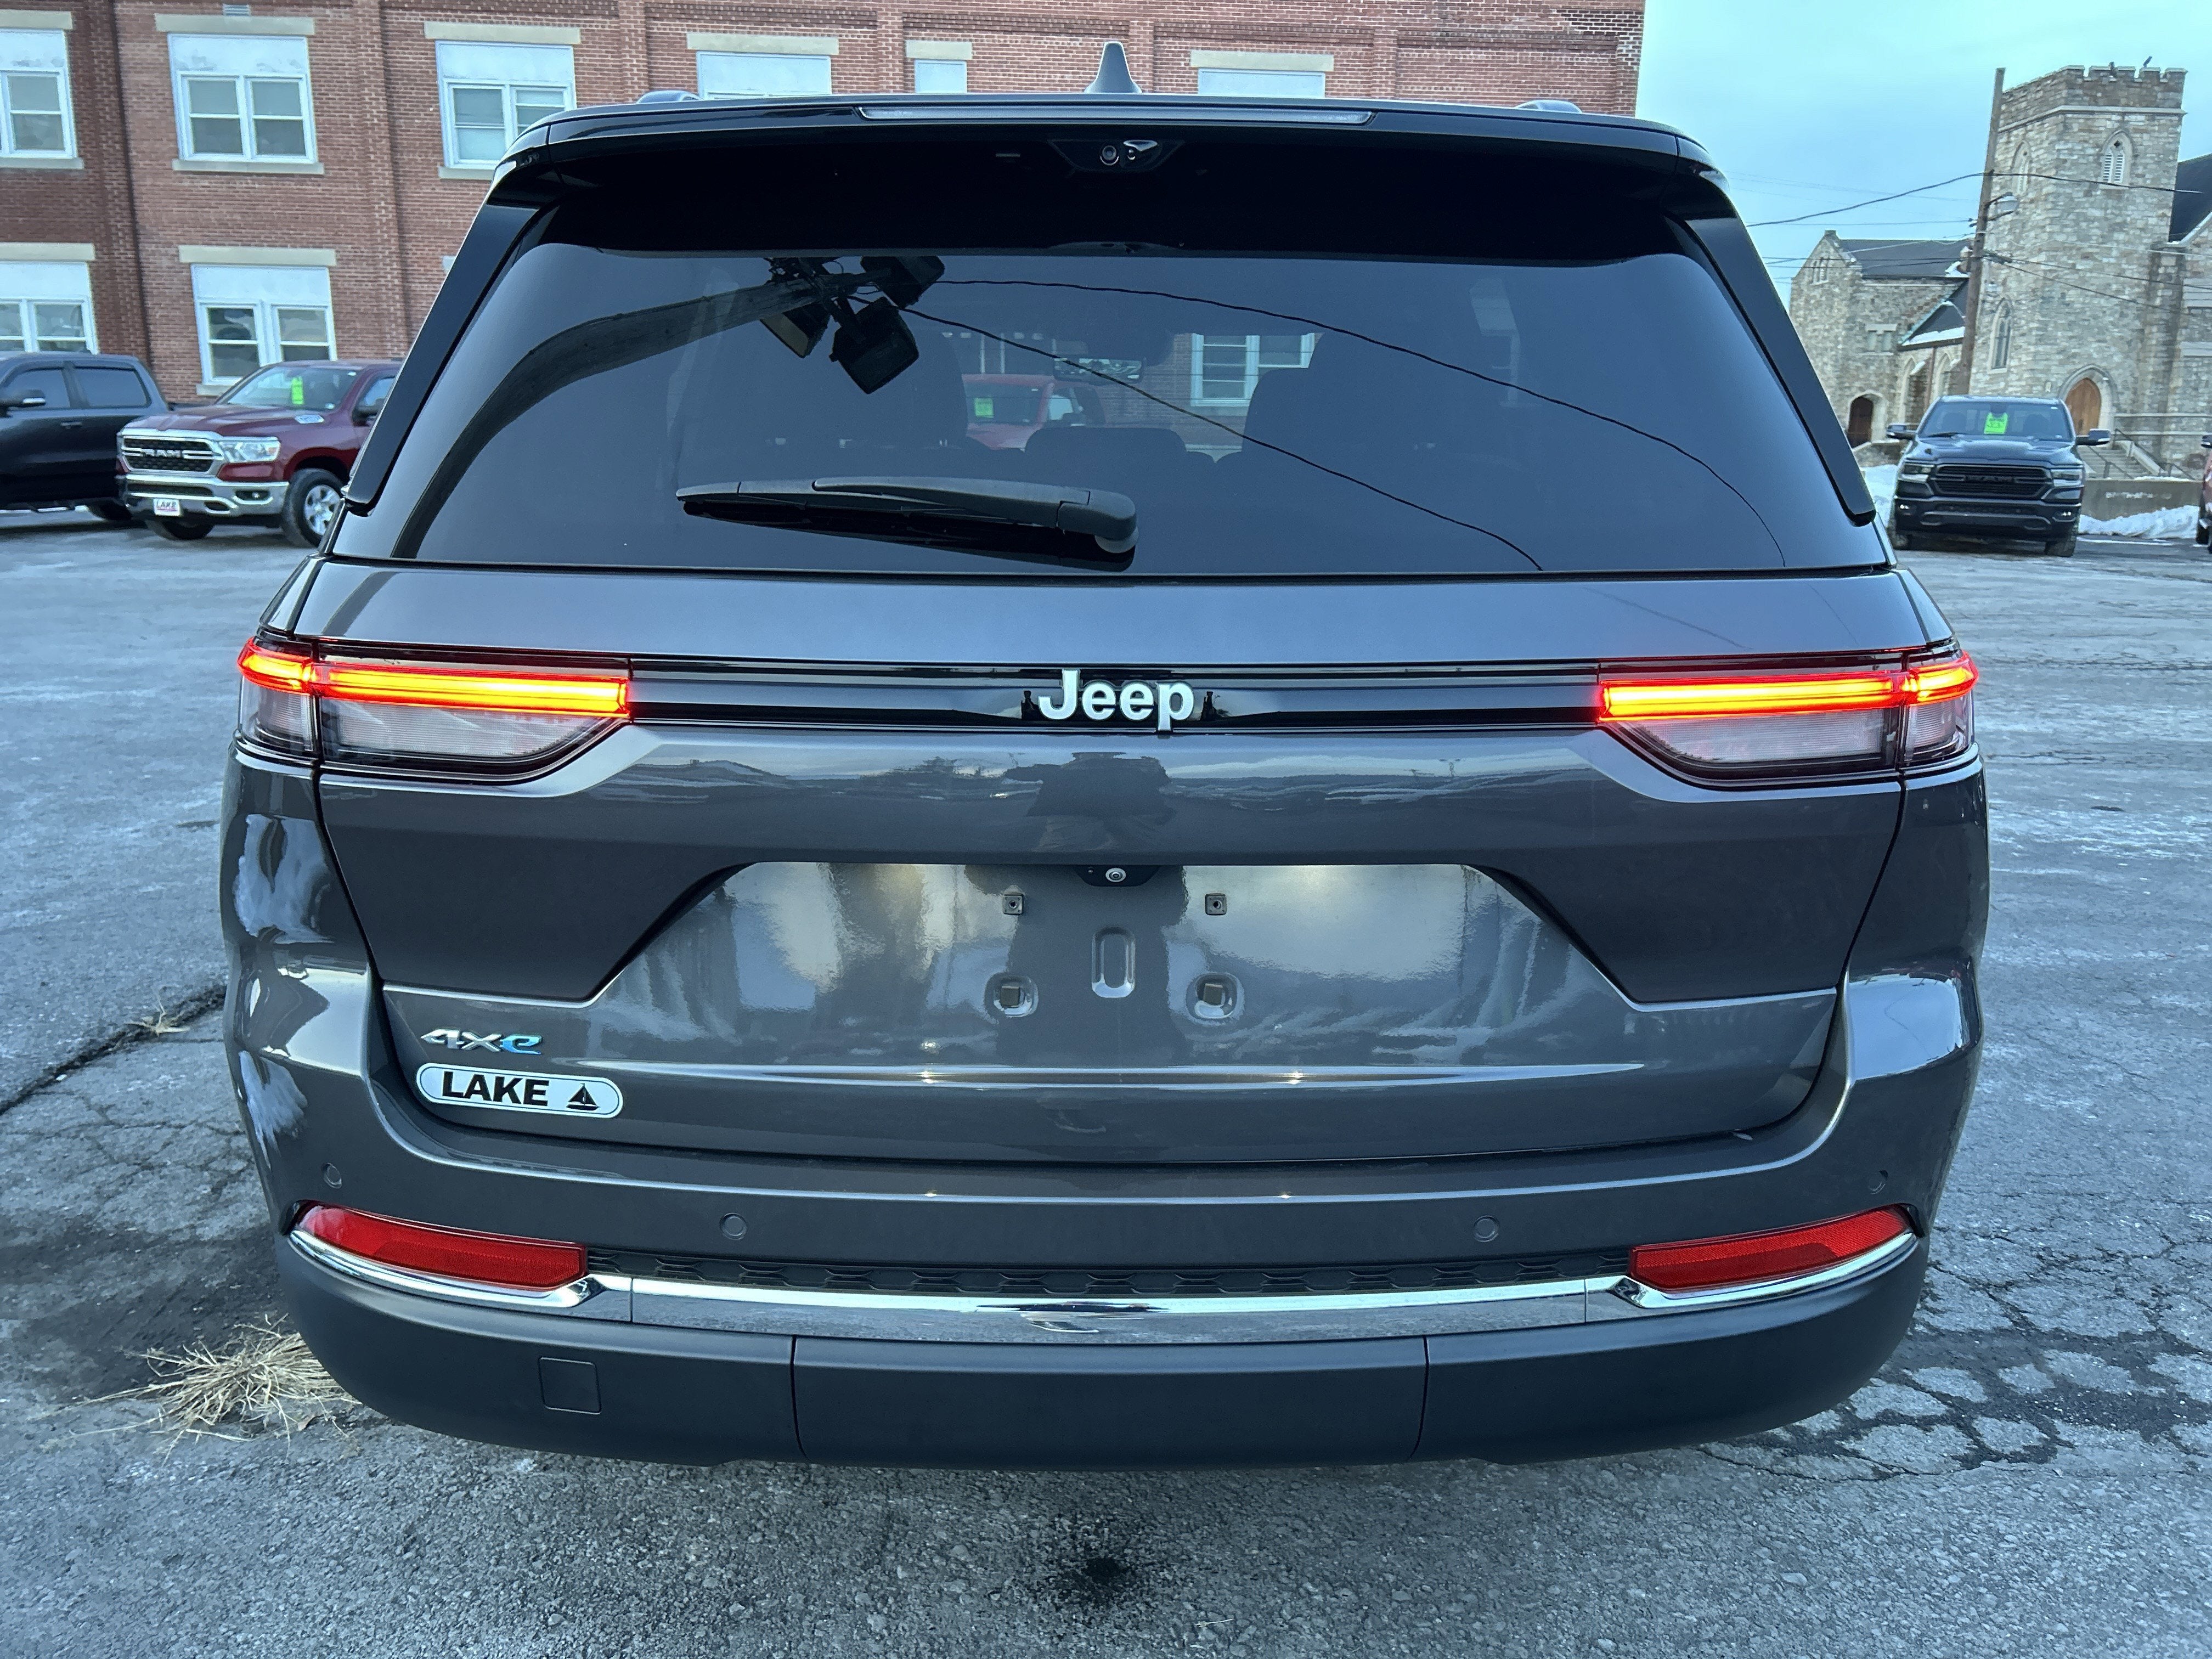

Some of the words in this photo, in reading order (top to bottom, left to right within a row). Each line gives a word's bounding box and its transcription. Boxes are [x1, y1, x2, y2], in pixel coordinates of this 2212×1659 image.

[142, 448, 181, 458] RAM
[1039, 669, 1195, 731] Jeep
[442, 1071, 550, 1107] LAKE
